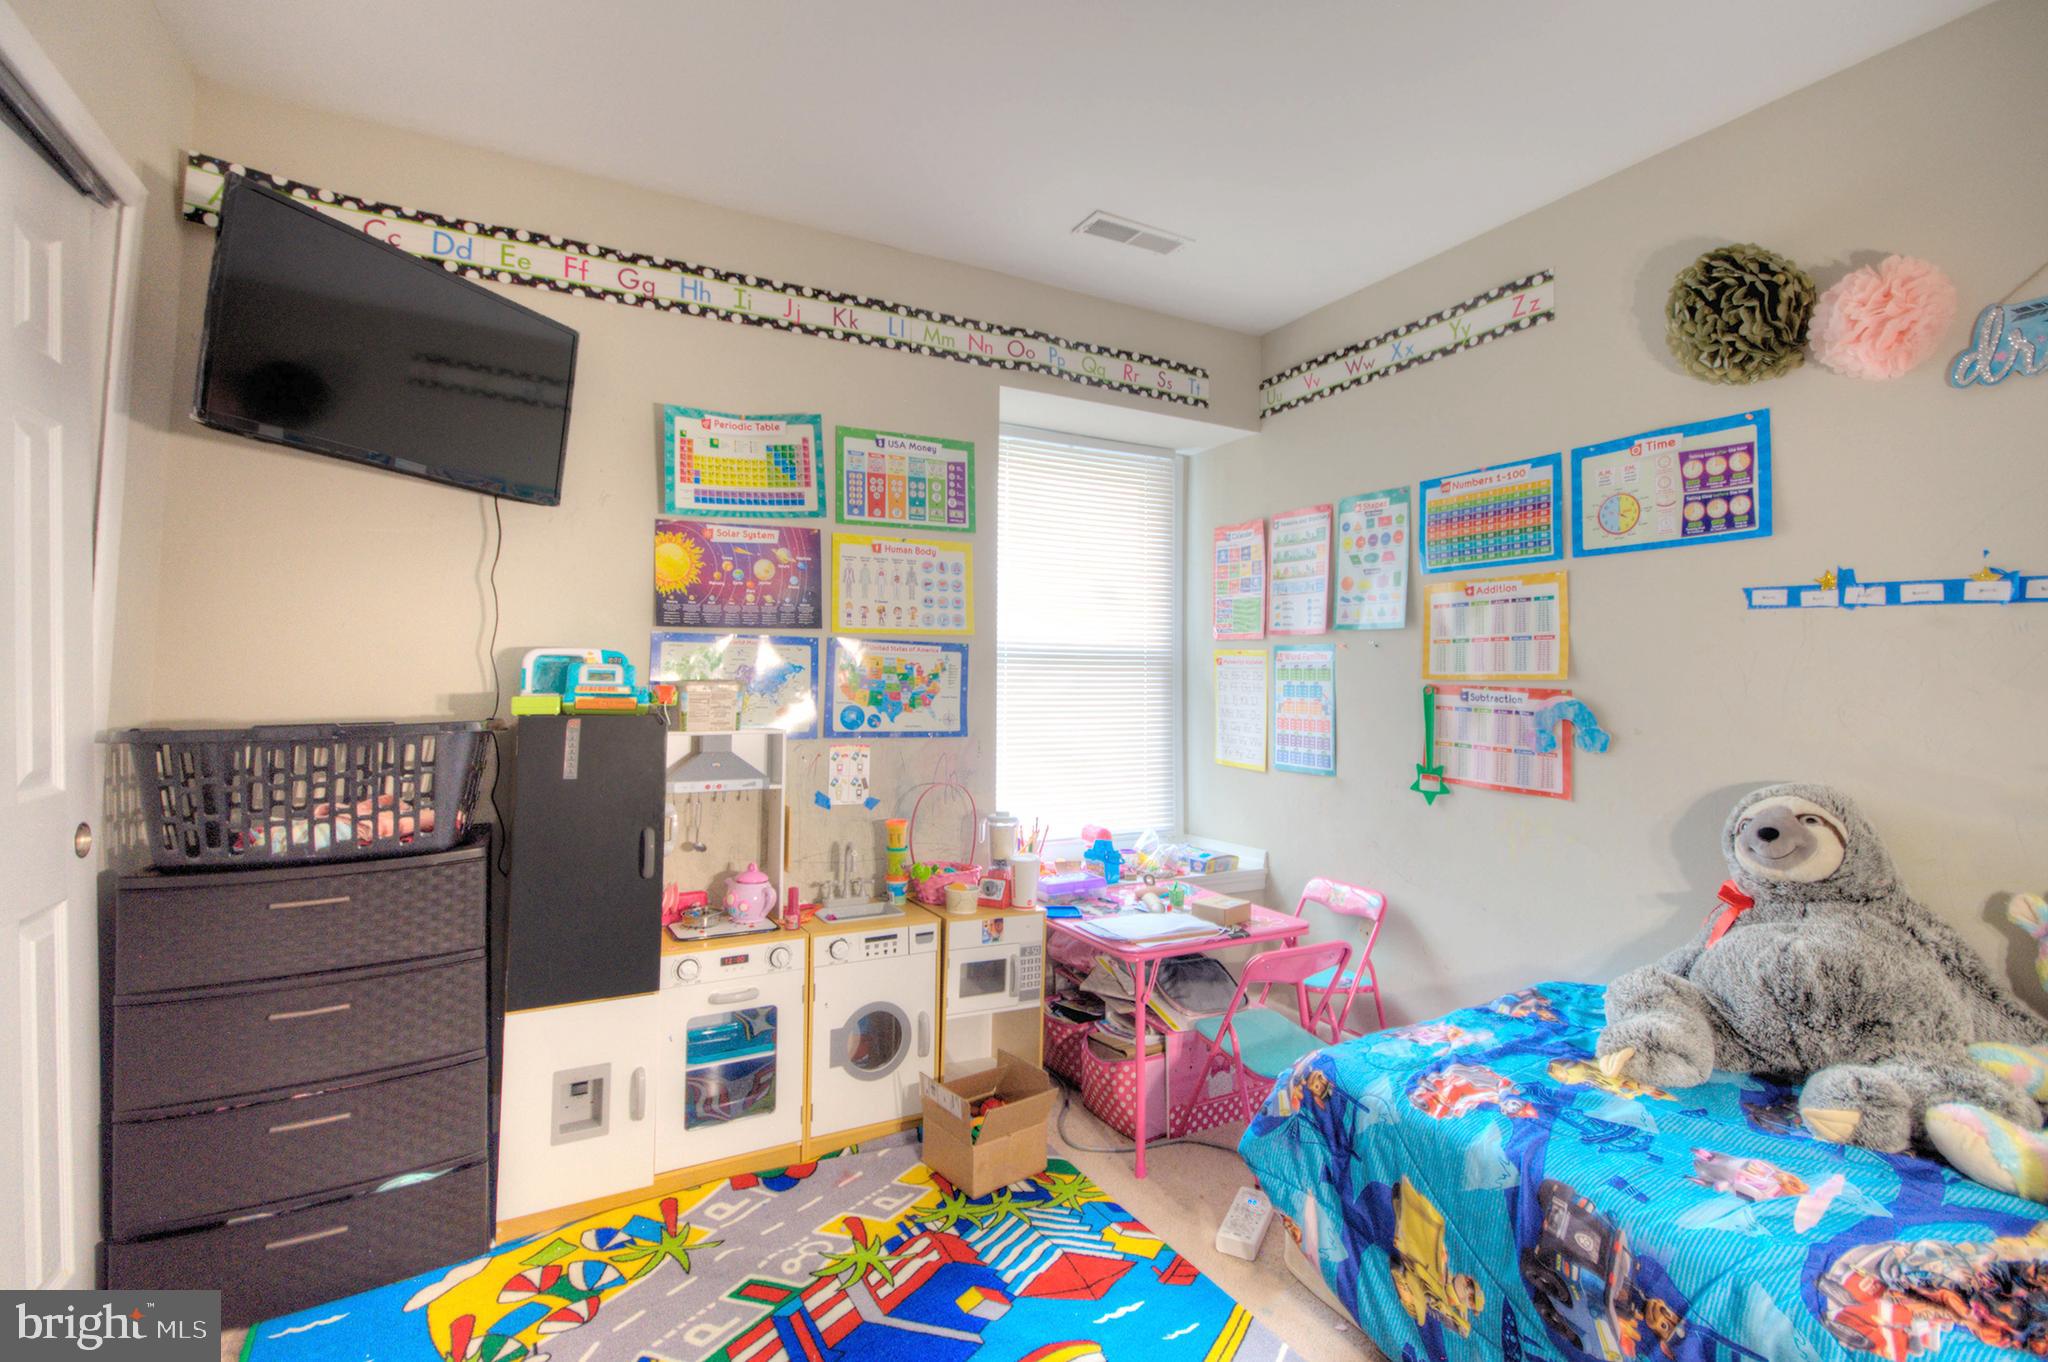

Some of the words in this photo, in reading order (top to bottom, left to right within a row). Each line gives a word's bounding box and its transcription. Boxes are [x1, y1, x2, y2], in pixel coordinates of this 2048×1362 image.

[432, 231, 473, 261] Dd
[501, 243, 531, 271] Ee
[564, 255, 590, 281] Ff
[617, 267, 655, 301] Gg
[680, 277, 711, 303] Hh
[733, 287, 752, 310] Ii
[783, 298, 801, 324] Jj
[833, 307, 859, 331] Kk
[923, 327, 955, 348] Mm
[968, 333, 993, 355] Nn
[1007, 339, 1036, 359] Oo
[1049, 346, 1066, 370] Pp
[1081, 355, 1106, 382] Qq
[1123, 363, 1140, 384] Rr
[1157, 371, 1173, 391] Ss
[1188, 378, 1201, 396] Tt
[1304, 373, 1320, 390] Vv
[1345, 355, 1376, 375] Ww
[1391, 341, 1415, 361] Xx
[1450, 319, 1472, 346] Yy
[1512, 294, 1541, 319] Zz
[713, 419, 752, 431] Periodic
[755, 423, 781, 431] Table
[887, 440, 906, 449] USA
[908, 443, 937, 454] Money
[1646, 439, 1676, 451] Time
[1452, 475, 1493, 491] Numbers
[1496, 469, 1526, 482] 1-100
[716, 529, 740, 538] Solar
[743, 530, 775, 541] System
[884, 545, 912, 554] Human
[915, 546, 936, 557] Body
[1476, 584, 1517, 595] Addition
[1470, 693, 1523, 704] Subtraction
